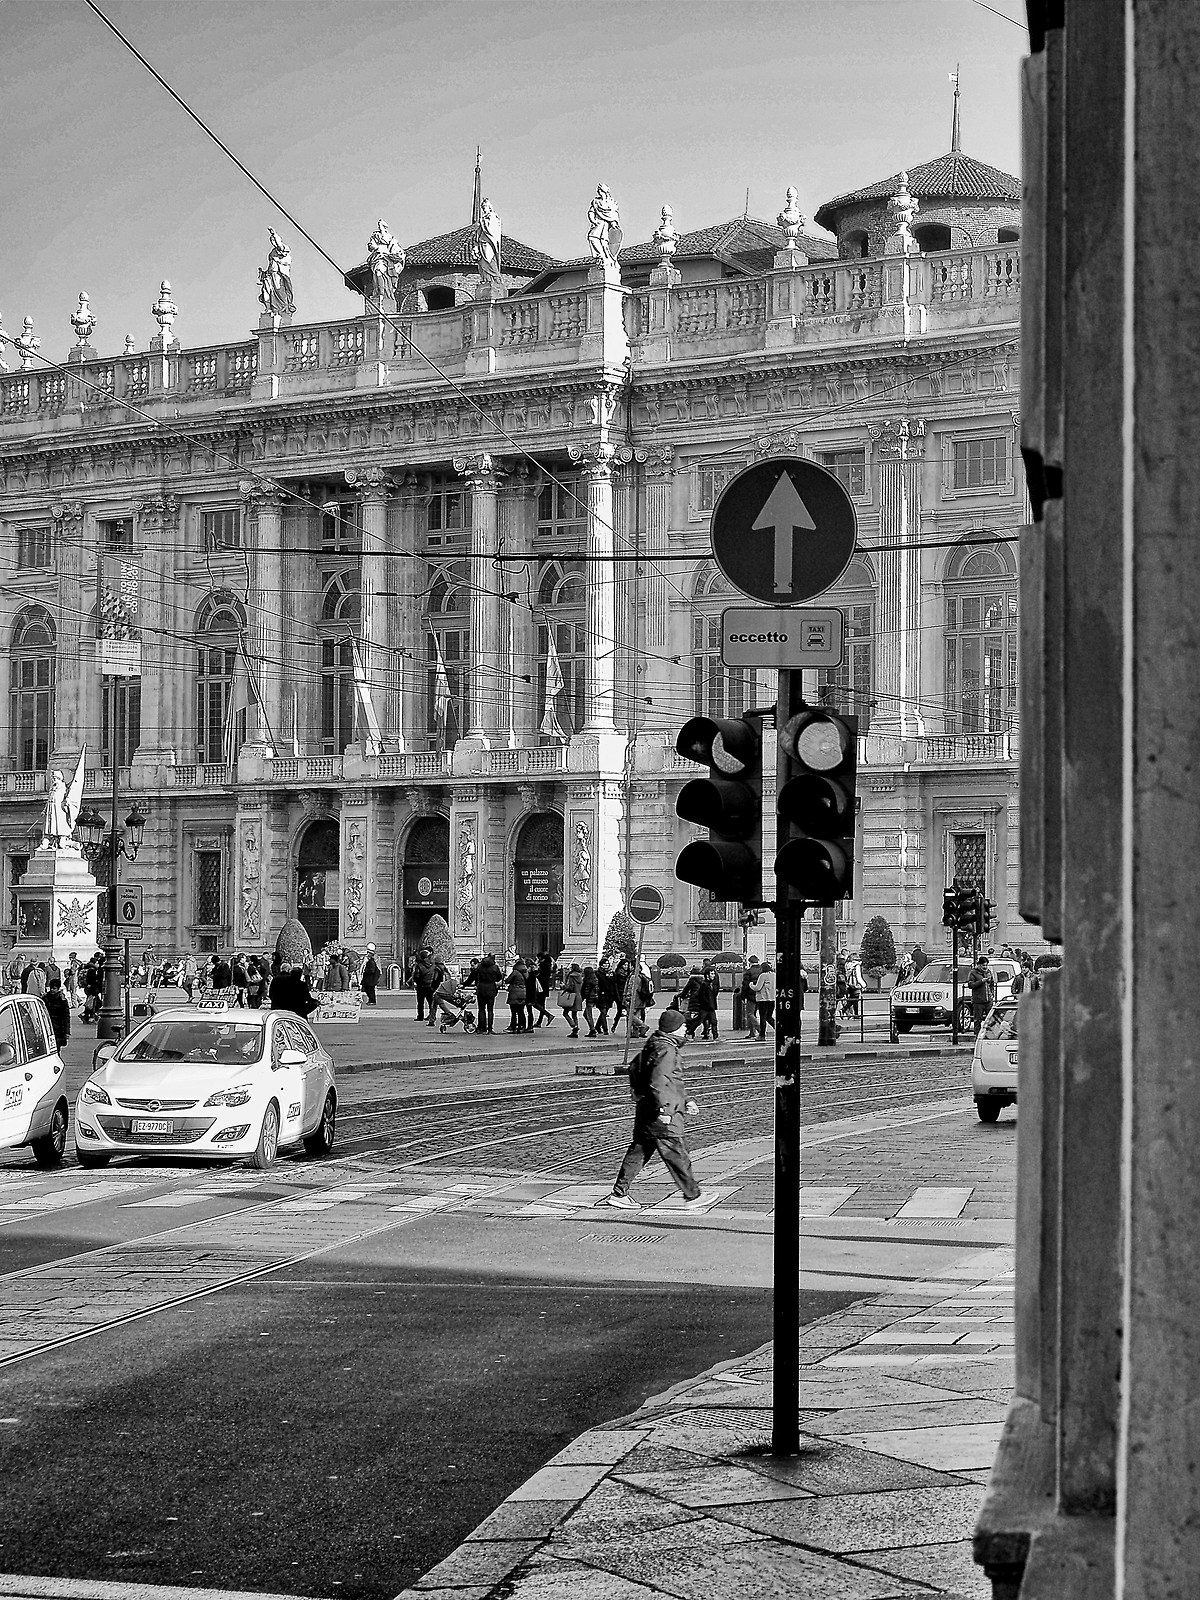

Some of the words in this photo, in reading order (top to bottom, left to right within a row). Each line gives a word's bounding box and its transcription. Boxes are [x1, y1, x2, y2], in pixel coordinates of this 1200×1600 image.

[730, 632, 788, 642] eccetto
[843, 890, 850, 899] A
[779, 1001, 790, 1009] 16
